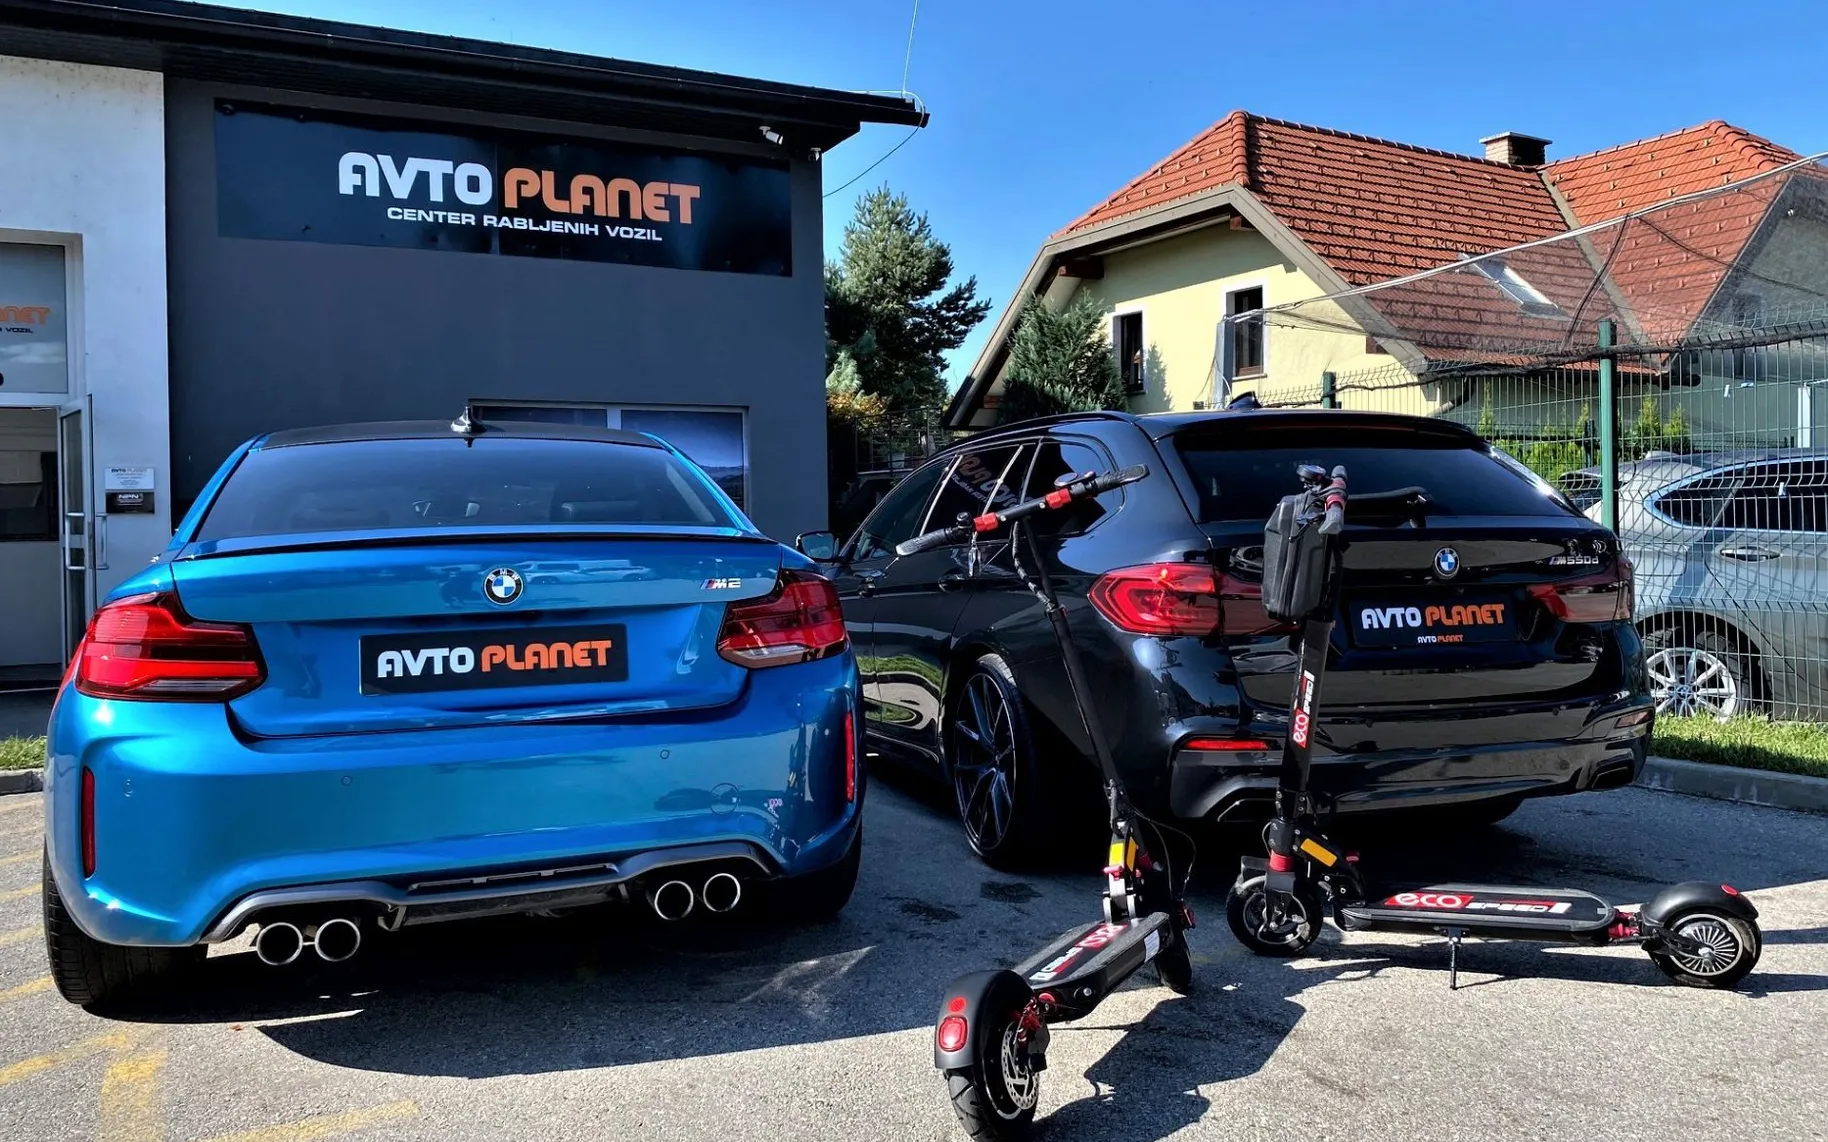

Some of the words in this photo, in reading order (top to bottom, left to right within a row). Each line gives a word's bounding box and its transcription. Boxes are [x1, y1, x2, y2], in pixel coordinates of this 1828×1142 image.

[338, 150, 493, 205] AVTO
[504, 166, 700, 225] PLANET
[387, 206, 476, 226] CENTER
[483, 214, 599, 236] RABLJENIH
[605, 223, 662, 242] VOZIL
[0, 305, 51, 325] NET
[1553, 555, 1599, 566] M550d
[708, 577, 742, 590] M2
[1361, 606, 1422, 630] AVTO
[1425, 603, 1504, 627] PLANET
[1417, 635, 1437, 644] AVTO
[1437, 634, 1463, 643] PLANET
[377, 646, 475, 678] AVTO
[481, 639, 612, 673] PLANET
[1293, 714, 1310, 743] eco
[1394, 892, 1463, 908] eco
